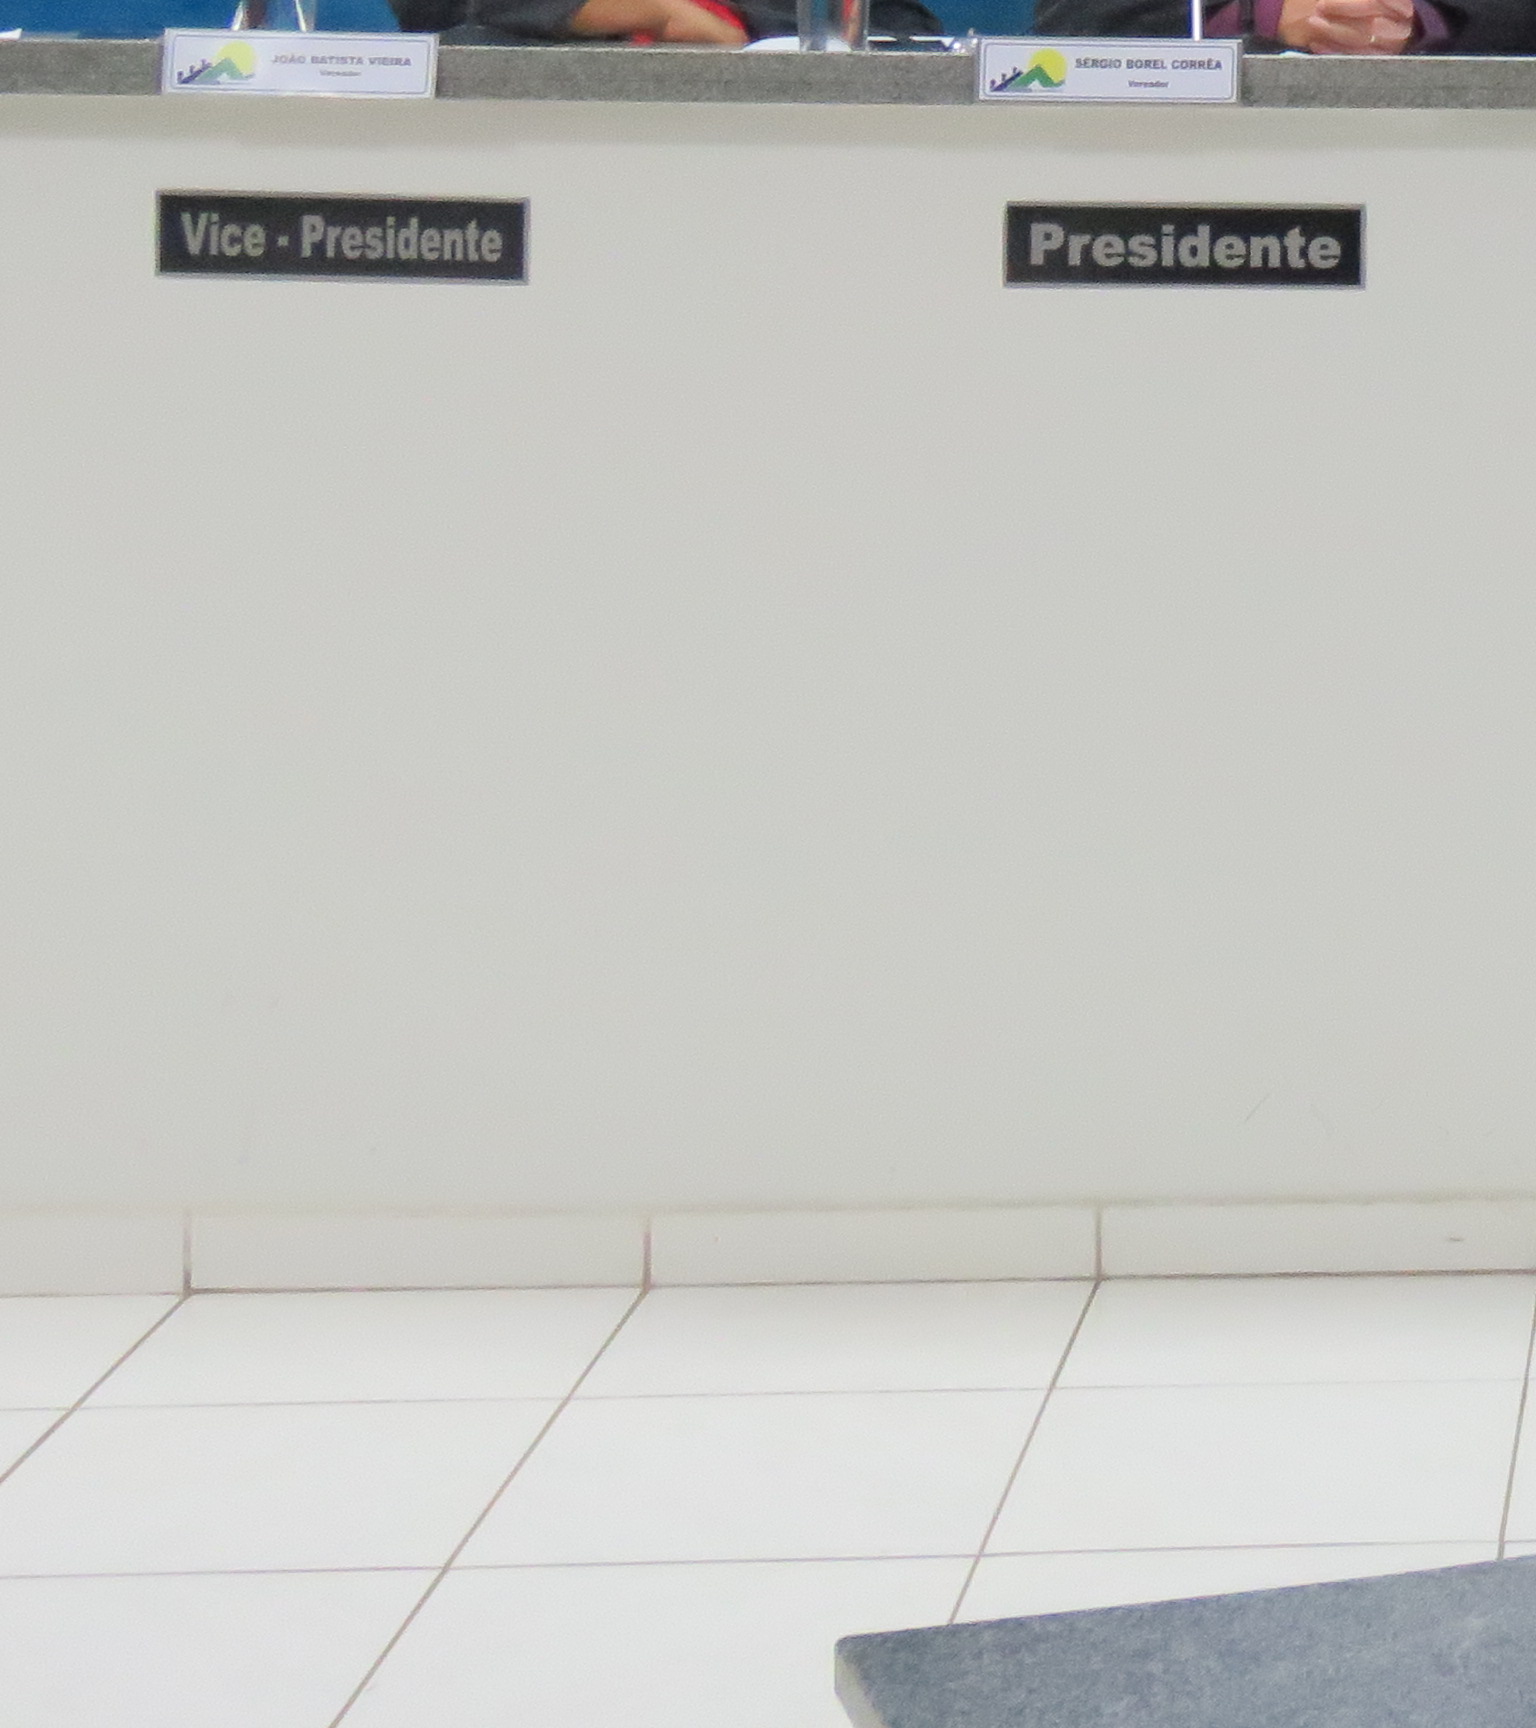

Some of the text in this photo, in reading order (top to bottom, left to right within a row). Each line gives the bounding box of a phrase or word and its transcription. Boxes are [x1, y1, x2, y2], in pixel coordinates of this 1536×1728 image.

[310, 55, 364, 66] BATISTA
[1126, 59, 1168, 70] BOREL
[180, 212, 266, 258] Vice
[300, 214, 502, 262] Presidente
[1029, 222, 1342, 269] Presidente
